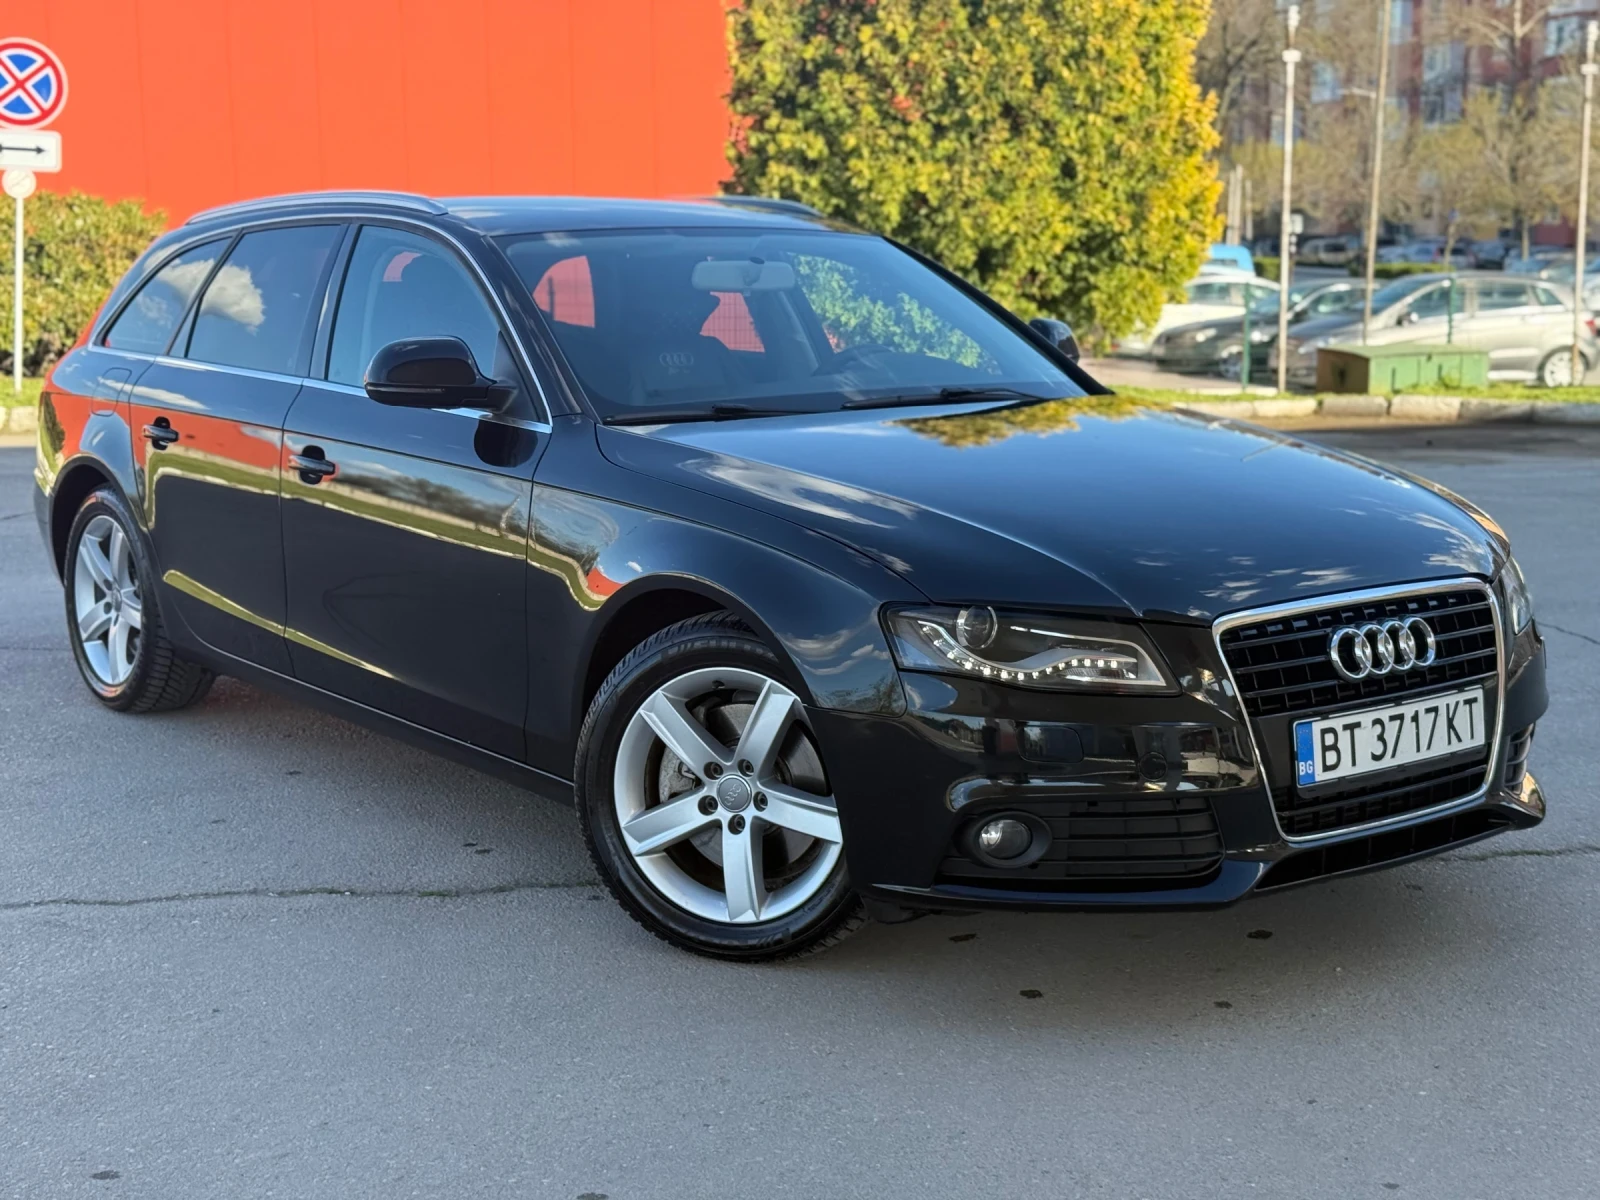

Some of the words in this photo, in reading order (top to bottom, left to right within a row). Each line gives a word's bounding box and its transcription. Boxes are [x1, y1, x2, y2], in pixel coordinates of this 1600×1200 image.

[1320, 721, 1362, 773] BT
[1370, 705, 1439, 762] 3717
[1445, 696, 1478, 746] KT
[1299, 760, 1313, 775] BG
